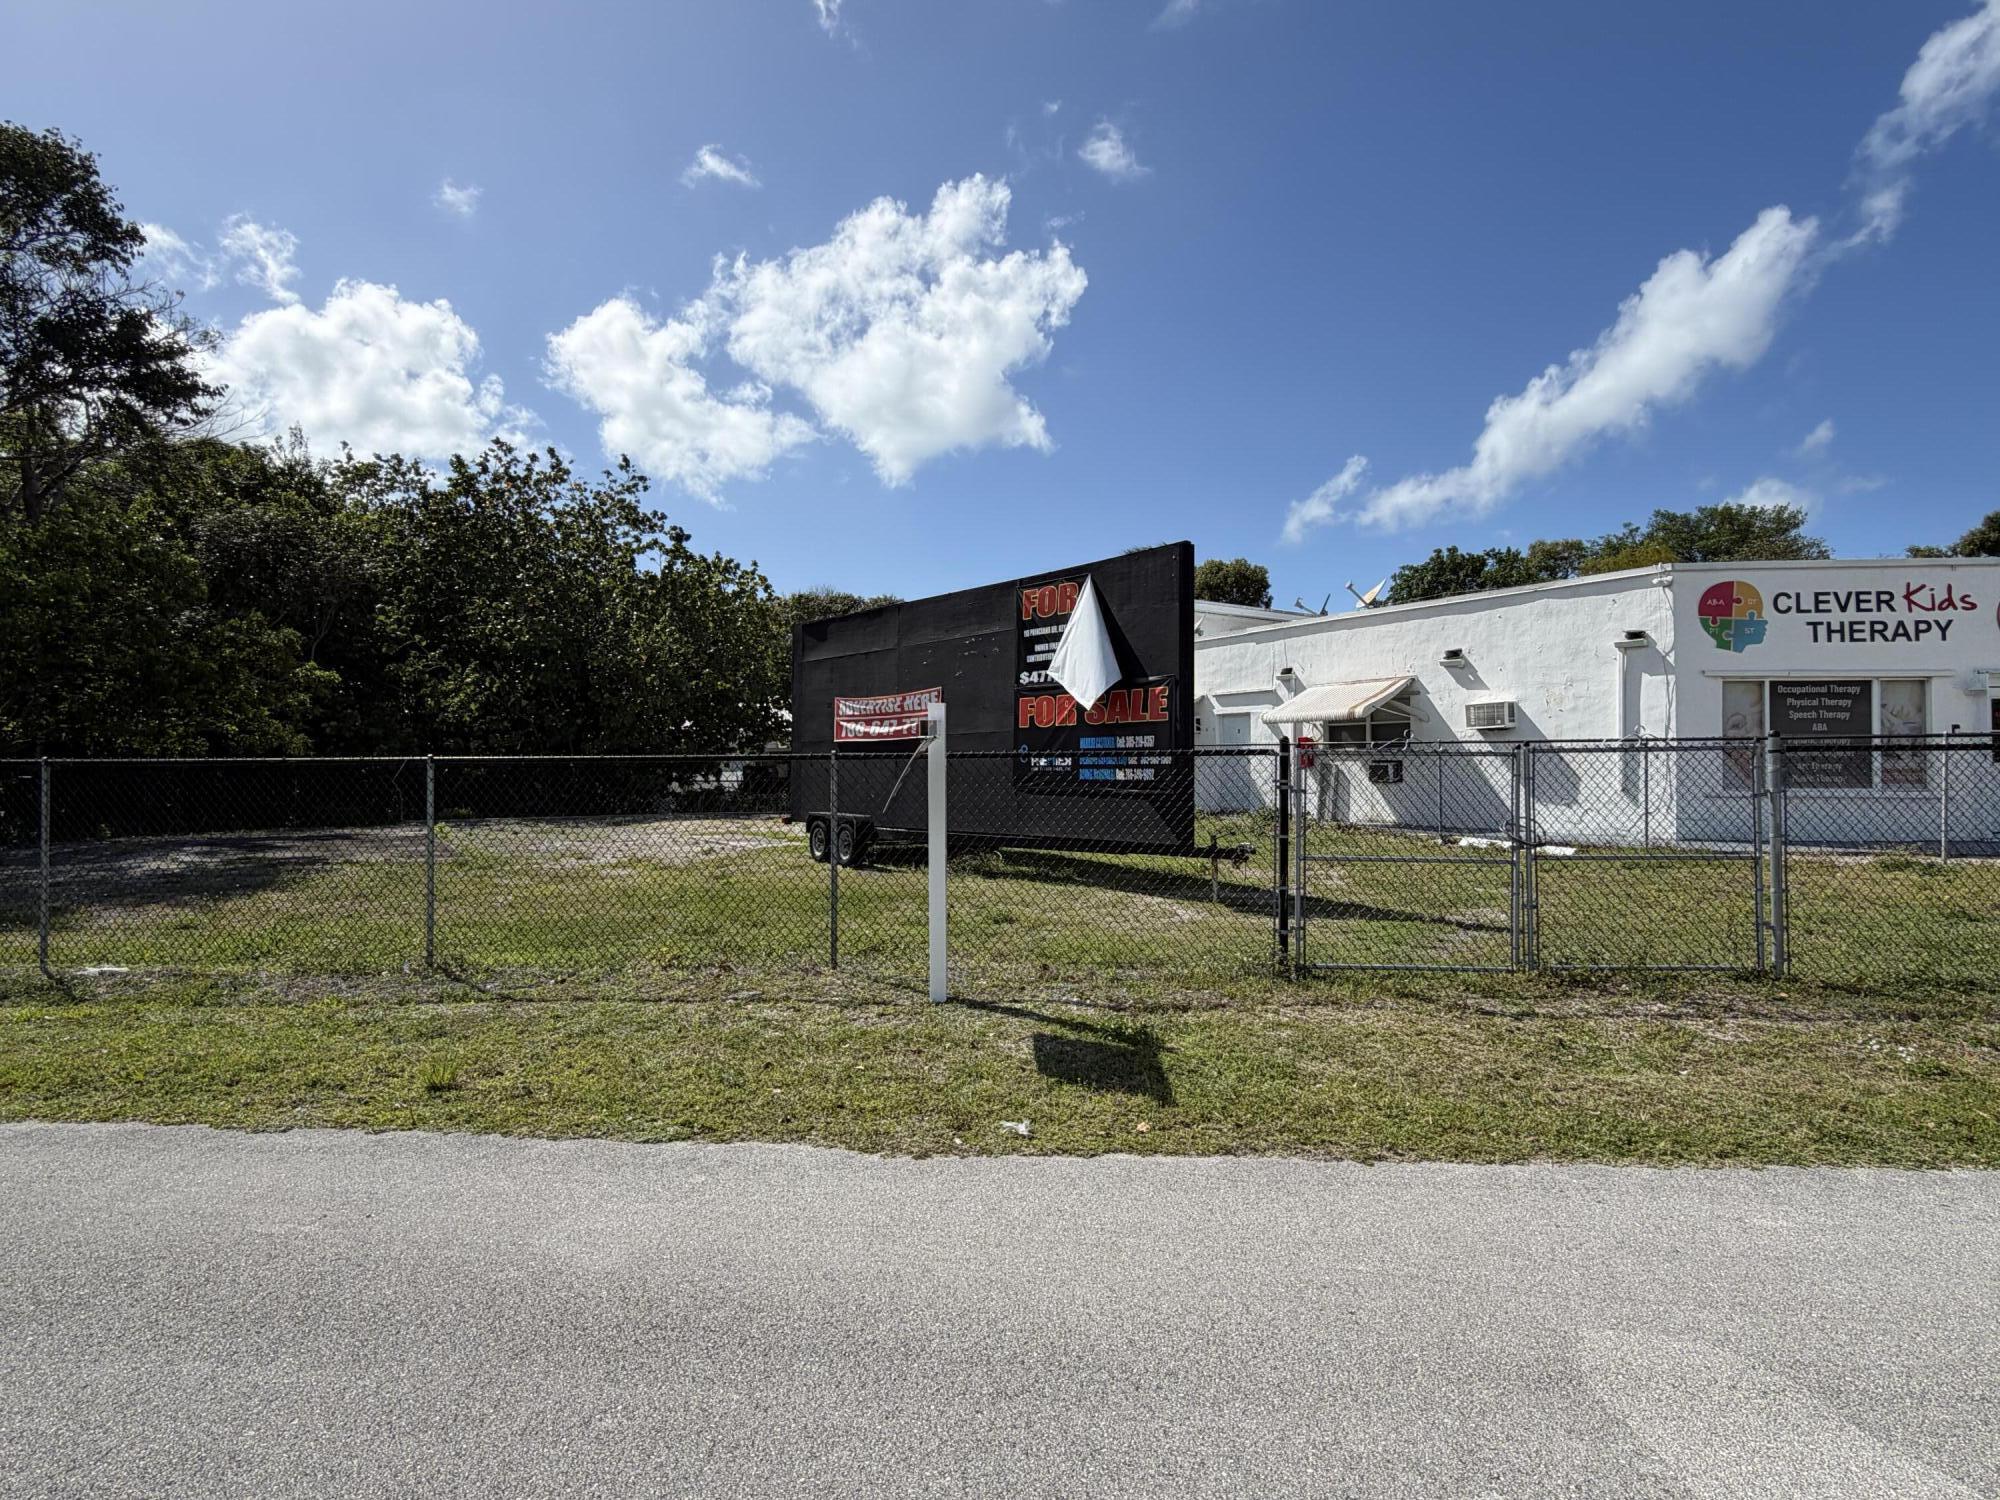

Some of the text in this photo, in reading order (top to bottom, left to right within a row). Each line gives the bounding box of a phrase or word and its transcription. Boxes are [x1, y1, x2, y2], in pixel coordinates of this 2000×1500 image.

[1023, 582, 1079, 620] FOR
[1773, 582, 1978, 614] CLEVER Kids
[1806, 619, 1953, 643] THERAPY
[1778, 684, 1861, 694] Occupational Therapy
[839, 692, 938, 715] ADVERTISE HERE
[1019, 686, 1169, 728] FOR SALE
[1786, 697, 1852, 708] Physical Therapy
[1789, 709, 1851, 720] Speech Therapy
[1812, 723, 1828, 731] ABA
